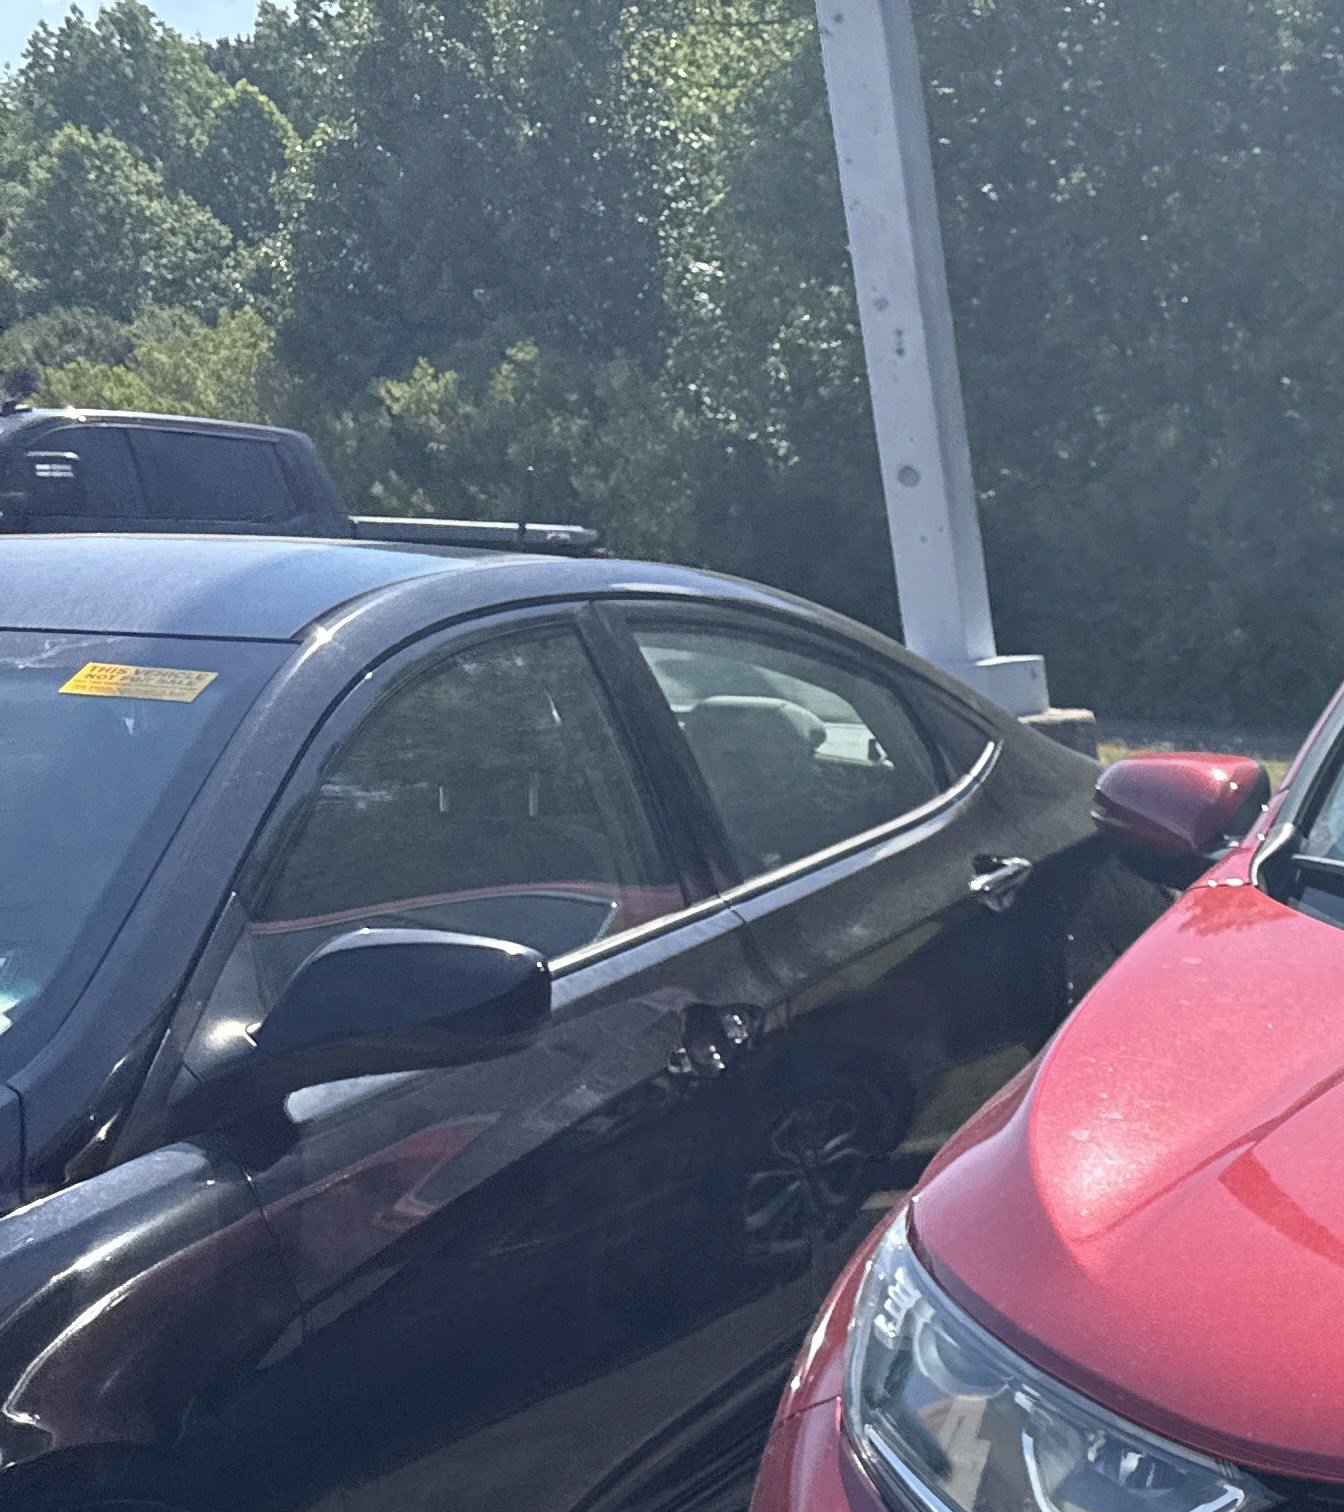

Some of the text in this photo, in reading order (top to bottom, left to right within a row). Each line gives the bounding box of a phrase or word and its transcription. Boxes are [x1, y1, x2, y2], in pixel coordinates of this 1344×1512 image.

[83, 673, 199, 687] NOT FOR SALE
[88, 665, 210, 681] THIS VEHICLE
